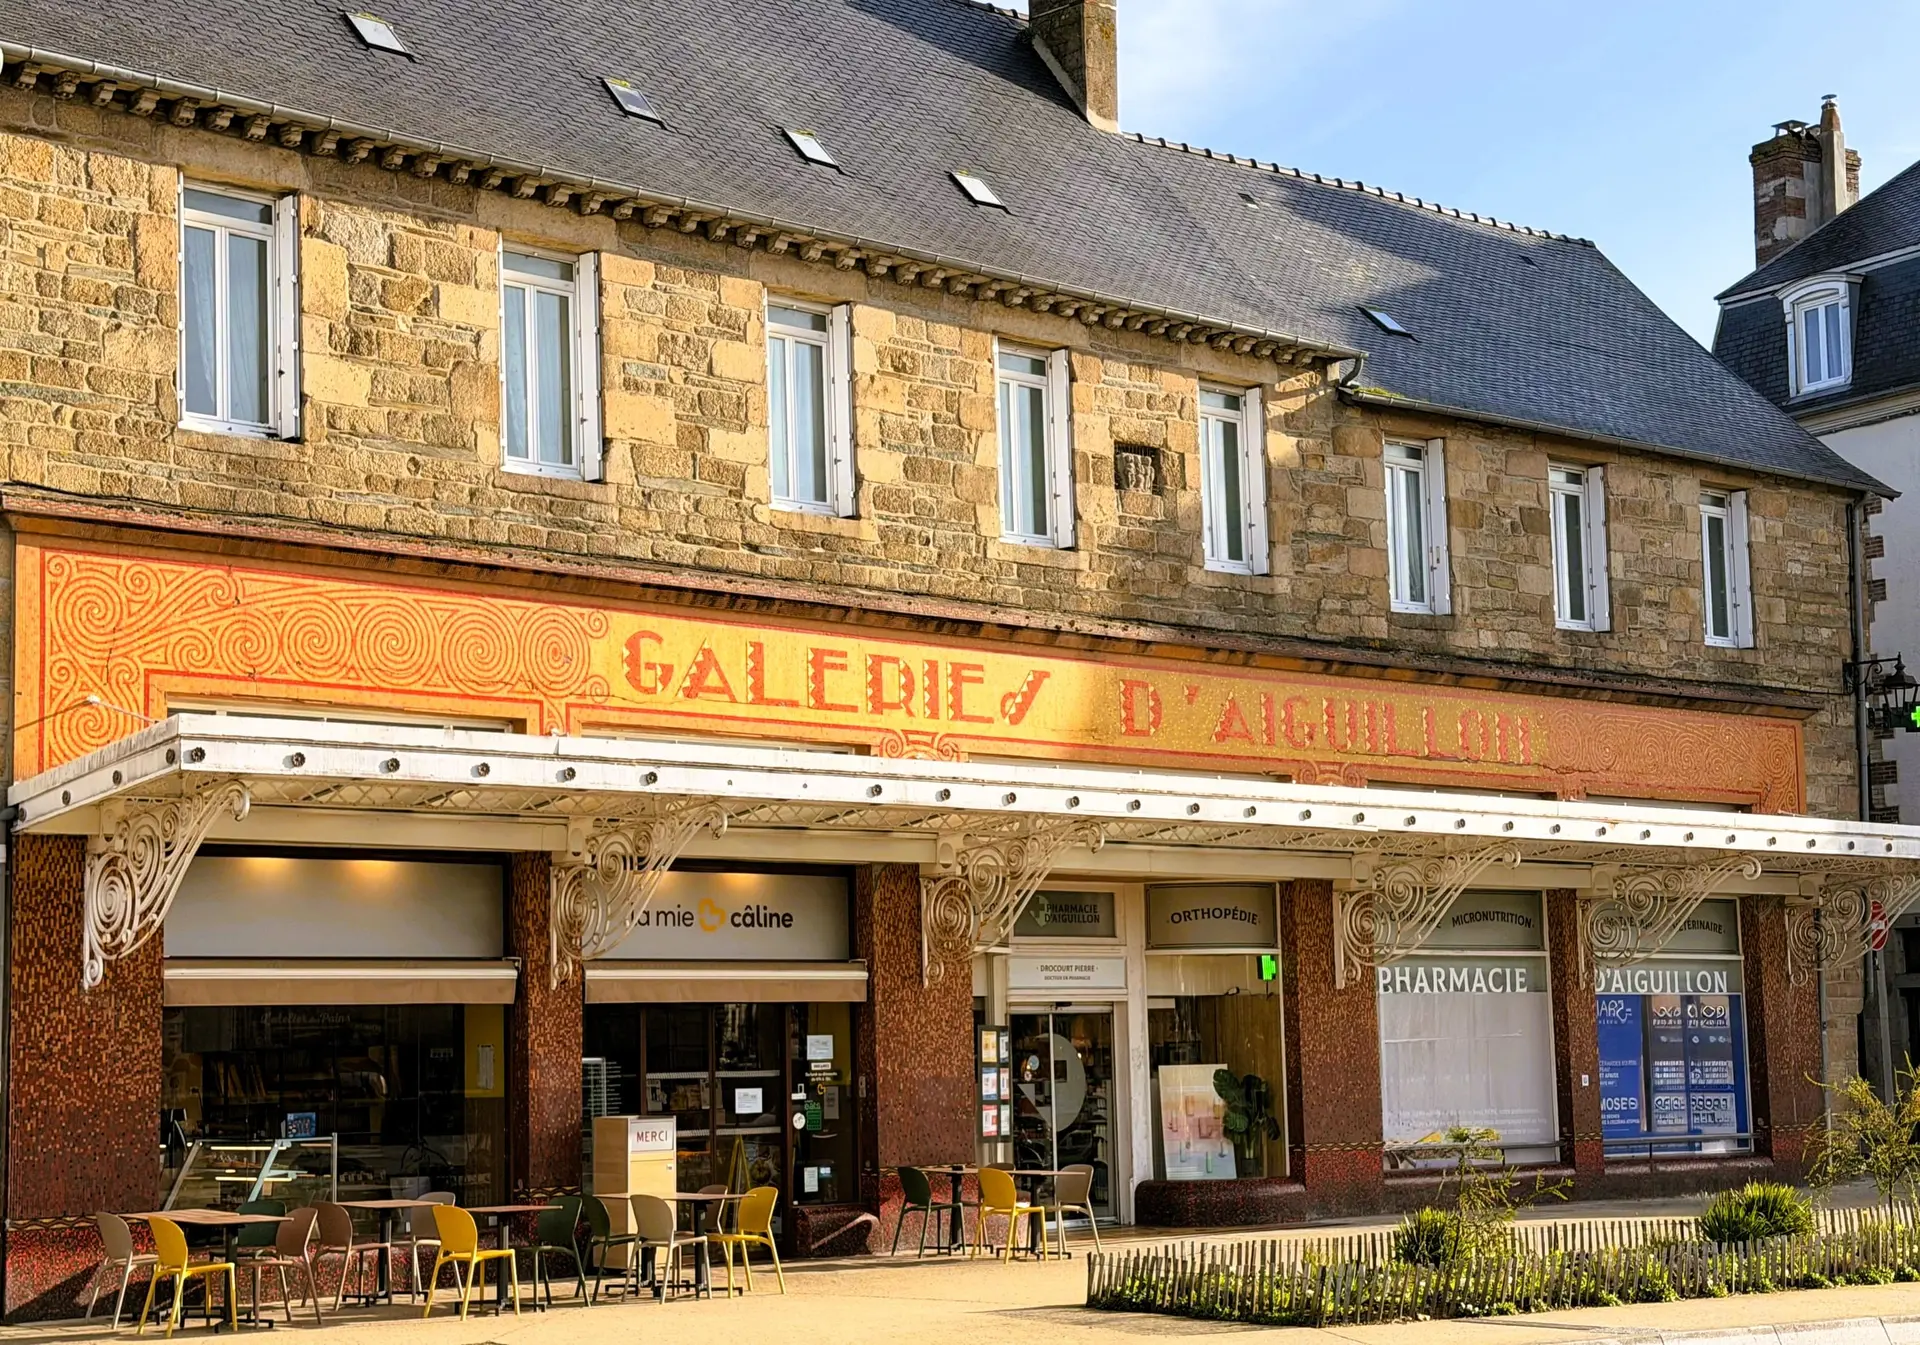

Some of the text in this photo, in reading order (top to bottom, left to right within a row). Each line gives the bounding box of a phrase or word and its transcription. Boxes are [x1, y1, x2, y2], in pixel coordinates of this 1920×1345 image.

[1118, 678, 1533, 766] D'AIGUILLON
[656, 903, 695, 927] mie
[730, 904, 794, 929] câline
[1044, 913, 1101, 924] D'AIGUILLON
[1046, 903, 1099, 914] PHARMACIE
[1170, 905, 1259, 926] ORTHOPÉDIE
[1451, 910, 1533, 929] MICRONUTRITION
[1074, 964, 1096, 973] PIERRE
[1377, 966, 1529, 994] PHARMACIE
[1594, 968, 1729, 994] D'AIGUILLON
[635, 1130, 669, 1142] MERCI
